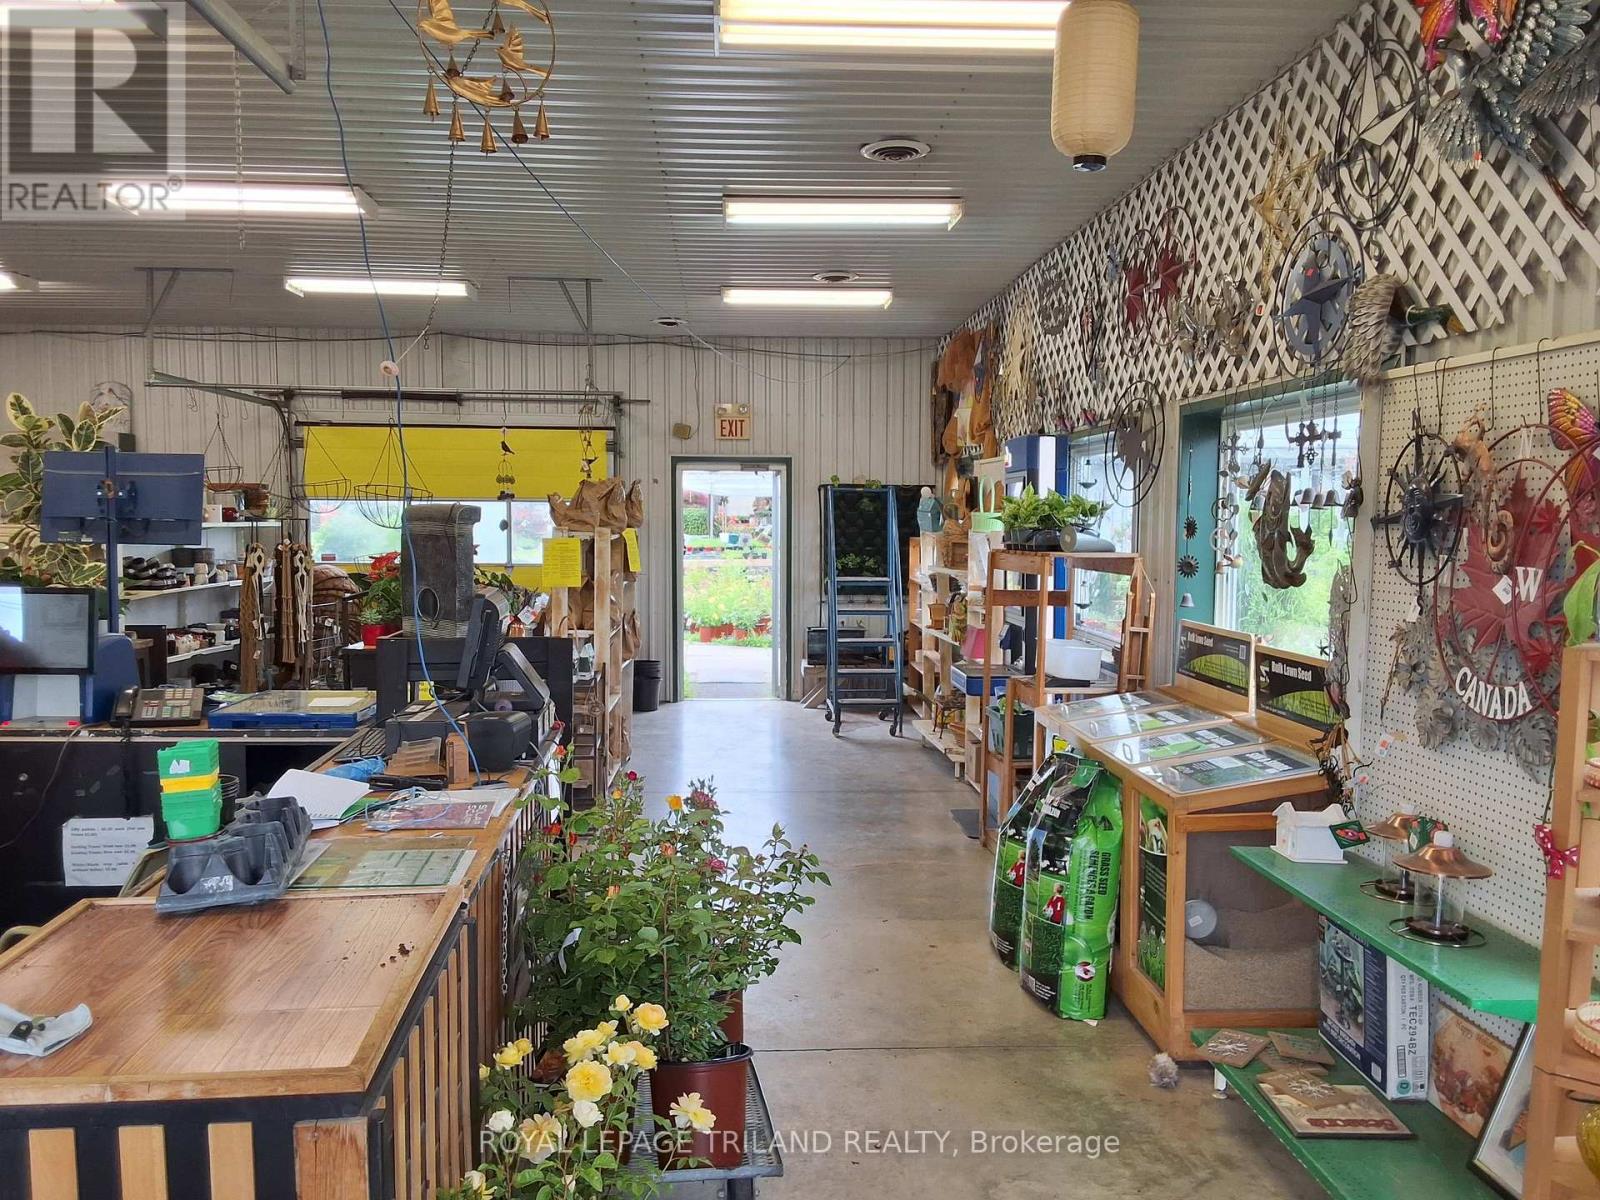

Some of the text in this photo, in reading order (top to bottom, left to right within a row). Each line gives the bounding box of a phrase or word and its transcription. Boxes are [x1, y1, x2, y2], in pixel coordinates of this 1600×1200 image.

[720, 419, 745, 437] EXIT
[1515, 566, 1543, 602] W
[1284, 664, 1298, 678] Lawn
[1298, 667, 1312, 682] Seed
[1456, 666, 1533, 719] CANADA
[1098, 852, 1111, 896] GRASS SEED
[1056, 902, 1061, 911] 1
[1408, 1006, 1418, 1055] TEC294BZ
